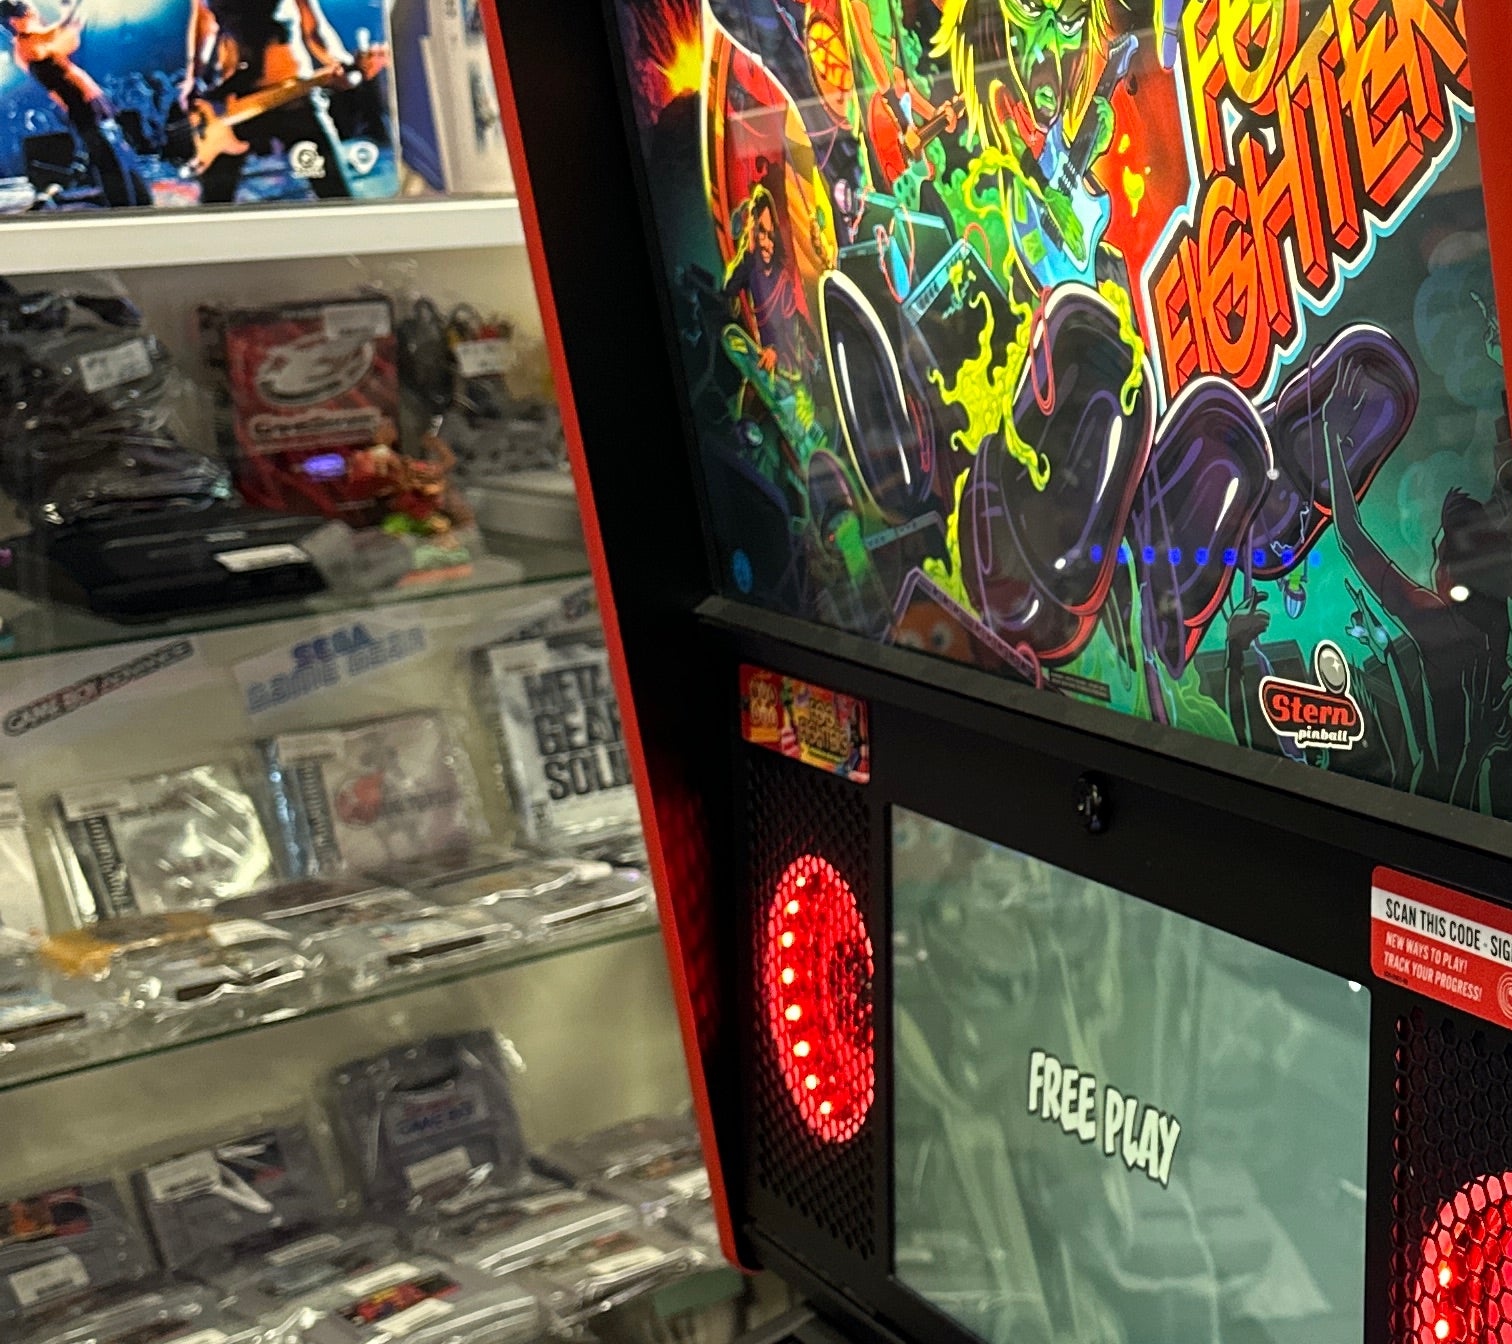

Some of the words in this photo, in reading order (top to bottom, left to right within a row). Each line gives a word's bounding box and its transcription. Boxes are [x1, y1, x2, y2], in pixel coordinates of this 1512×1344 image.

[1270, 692, 1357, 728] Stern
[1297, 724, 1349, 744] pinball
[1385, 897, 1417, 928] SCAN
[1419, 909, 1447, 938] THIS
[1449, 920, 1481, 950] CODE
[1385, 930, 1405, 950] NEW
[1406, 939, 1429, 961] WAYS
[1430, 947, 1441, 965] TO
[1442, 951, 1467, 975] PLAY!
[1383, 951, 1411, 973] TRACK
[1412, 961, 1433, 985] YOUR
[1433, 972, 1483, 1003] PROGRESS!
[1028, 1050, 1096, 1141] FREE
[1104, 1087, 1181, 1186] PLAY
